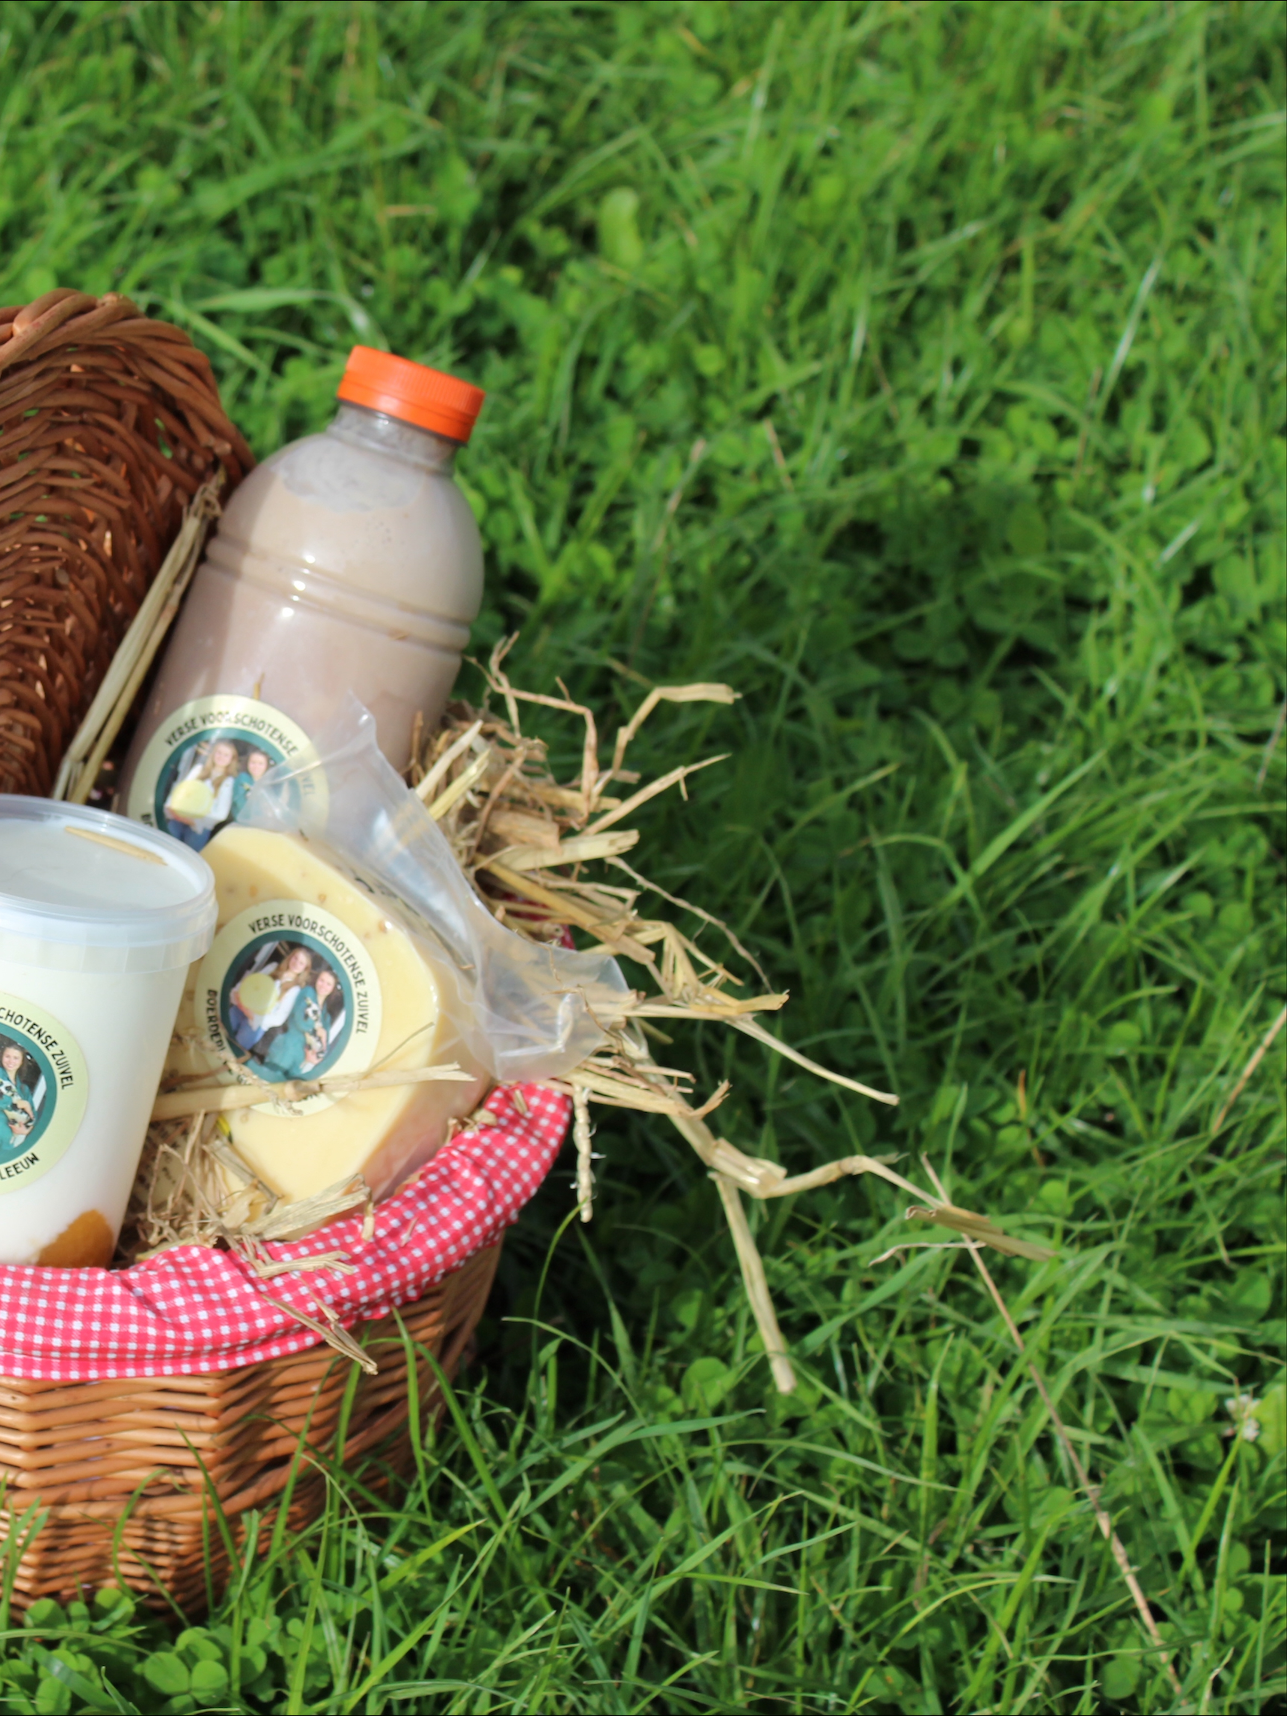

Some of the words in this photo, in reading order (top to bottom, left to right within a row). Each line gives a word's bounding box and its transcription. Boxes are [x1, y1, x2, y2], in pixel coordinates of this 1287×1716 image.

[165, 717, 198, 747] VERSE
[247, 913, 286, 935] VERSE
[288, 914, 367, 989] VOORSCHOTENSE
[355, 991, 369, 1035] ZUIVEL
[51, 1050, 75, 1090] ZUIVEL
